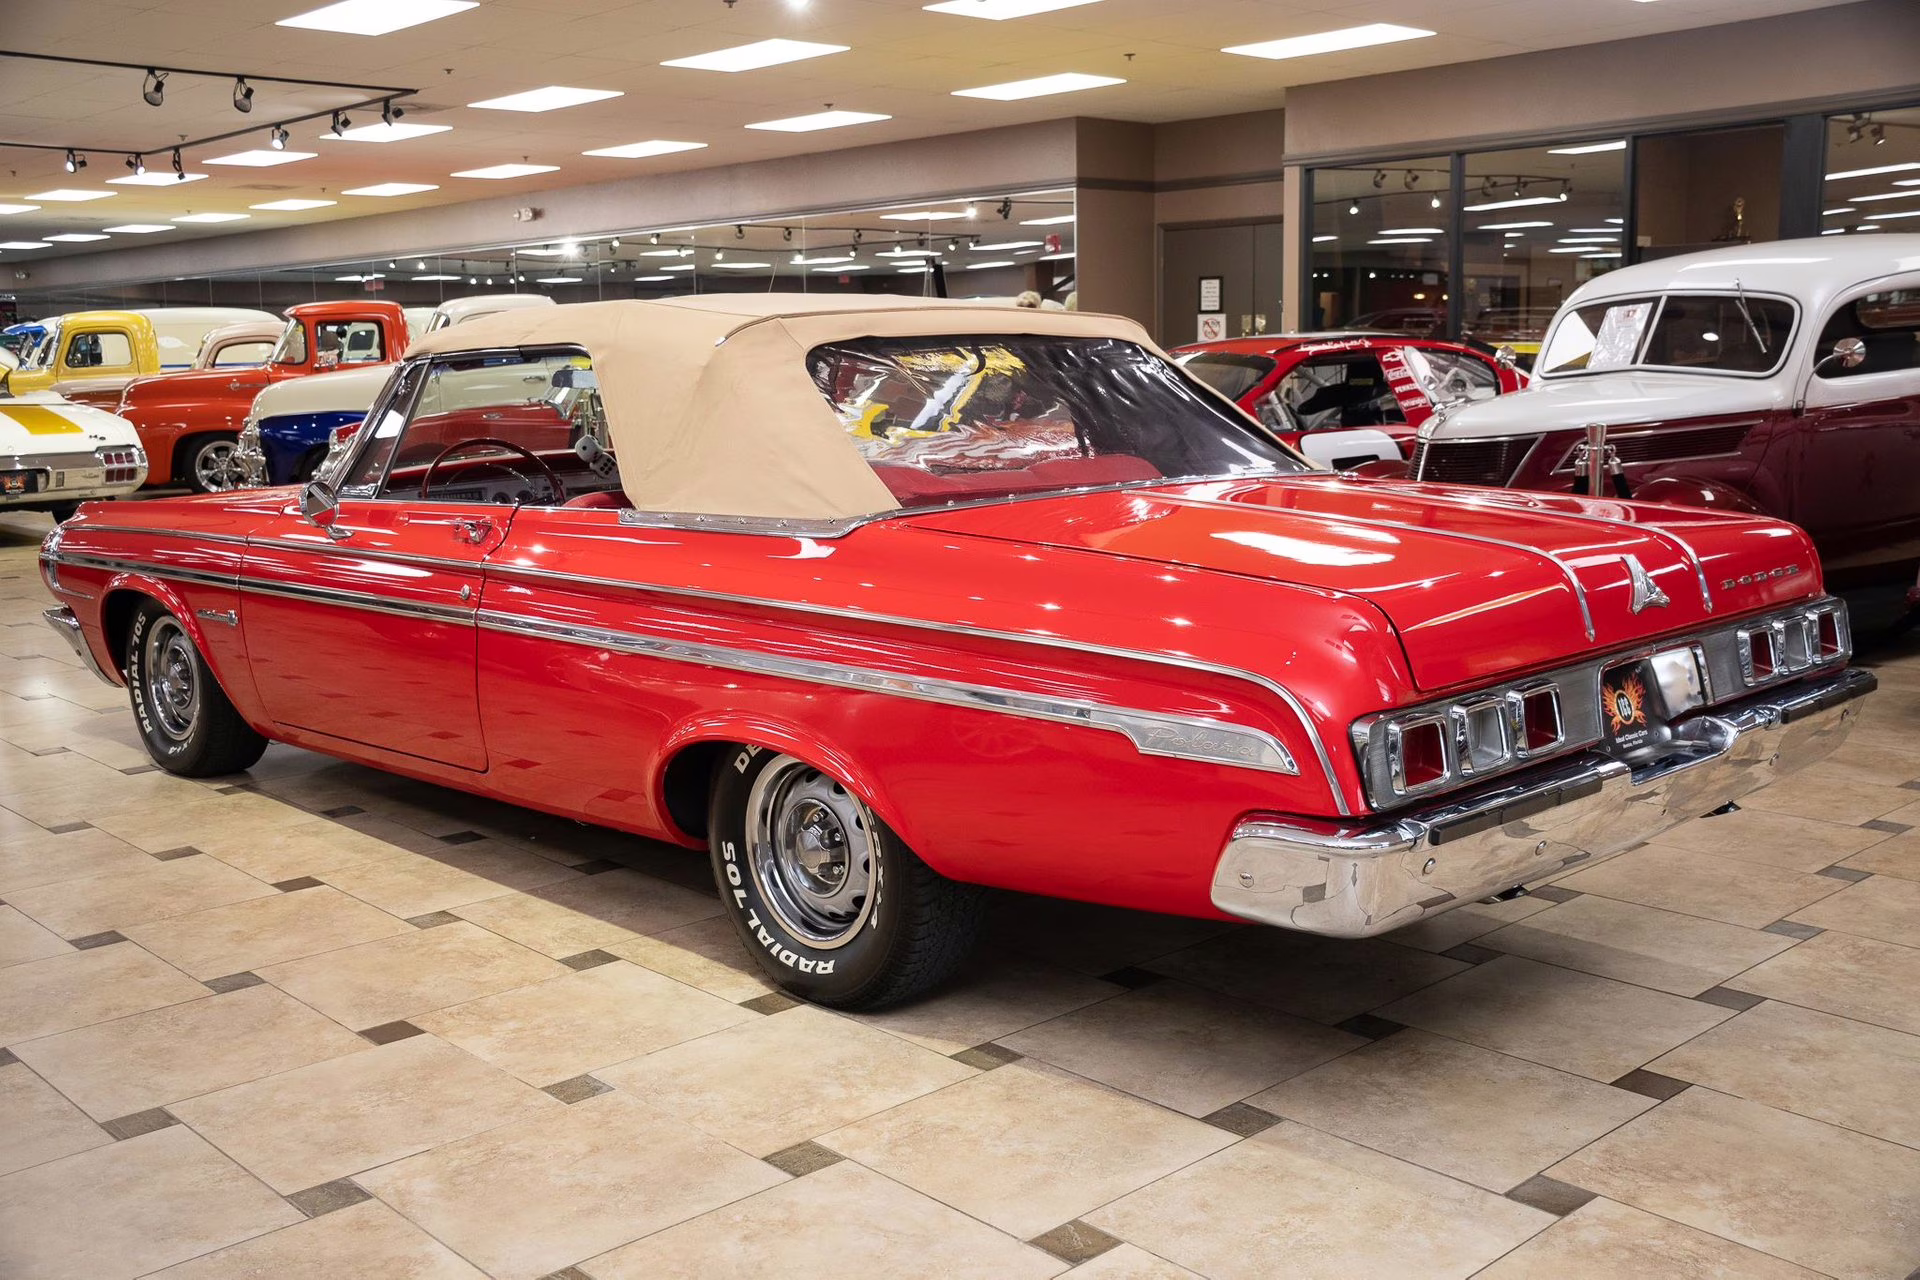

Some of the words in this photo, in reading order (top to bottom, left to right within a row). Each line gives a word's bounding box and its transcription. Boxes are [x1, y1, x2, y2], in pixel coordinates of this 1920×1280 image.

[1720, 564, 1799, 590] DODGE
[132, 612, 147, 648] 70S
[131, 651, 153, 734] RADIAL
[1145, 725, 1259, 757] Polara
[722, 841, 749, 909] 70S
[748, 908, 835, 975] RADIAL
